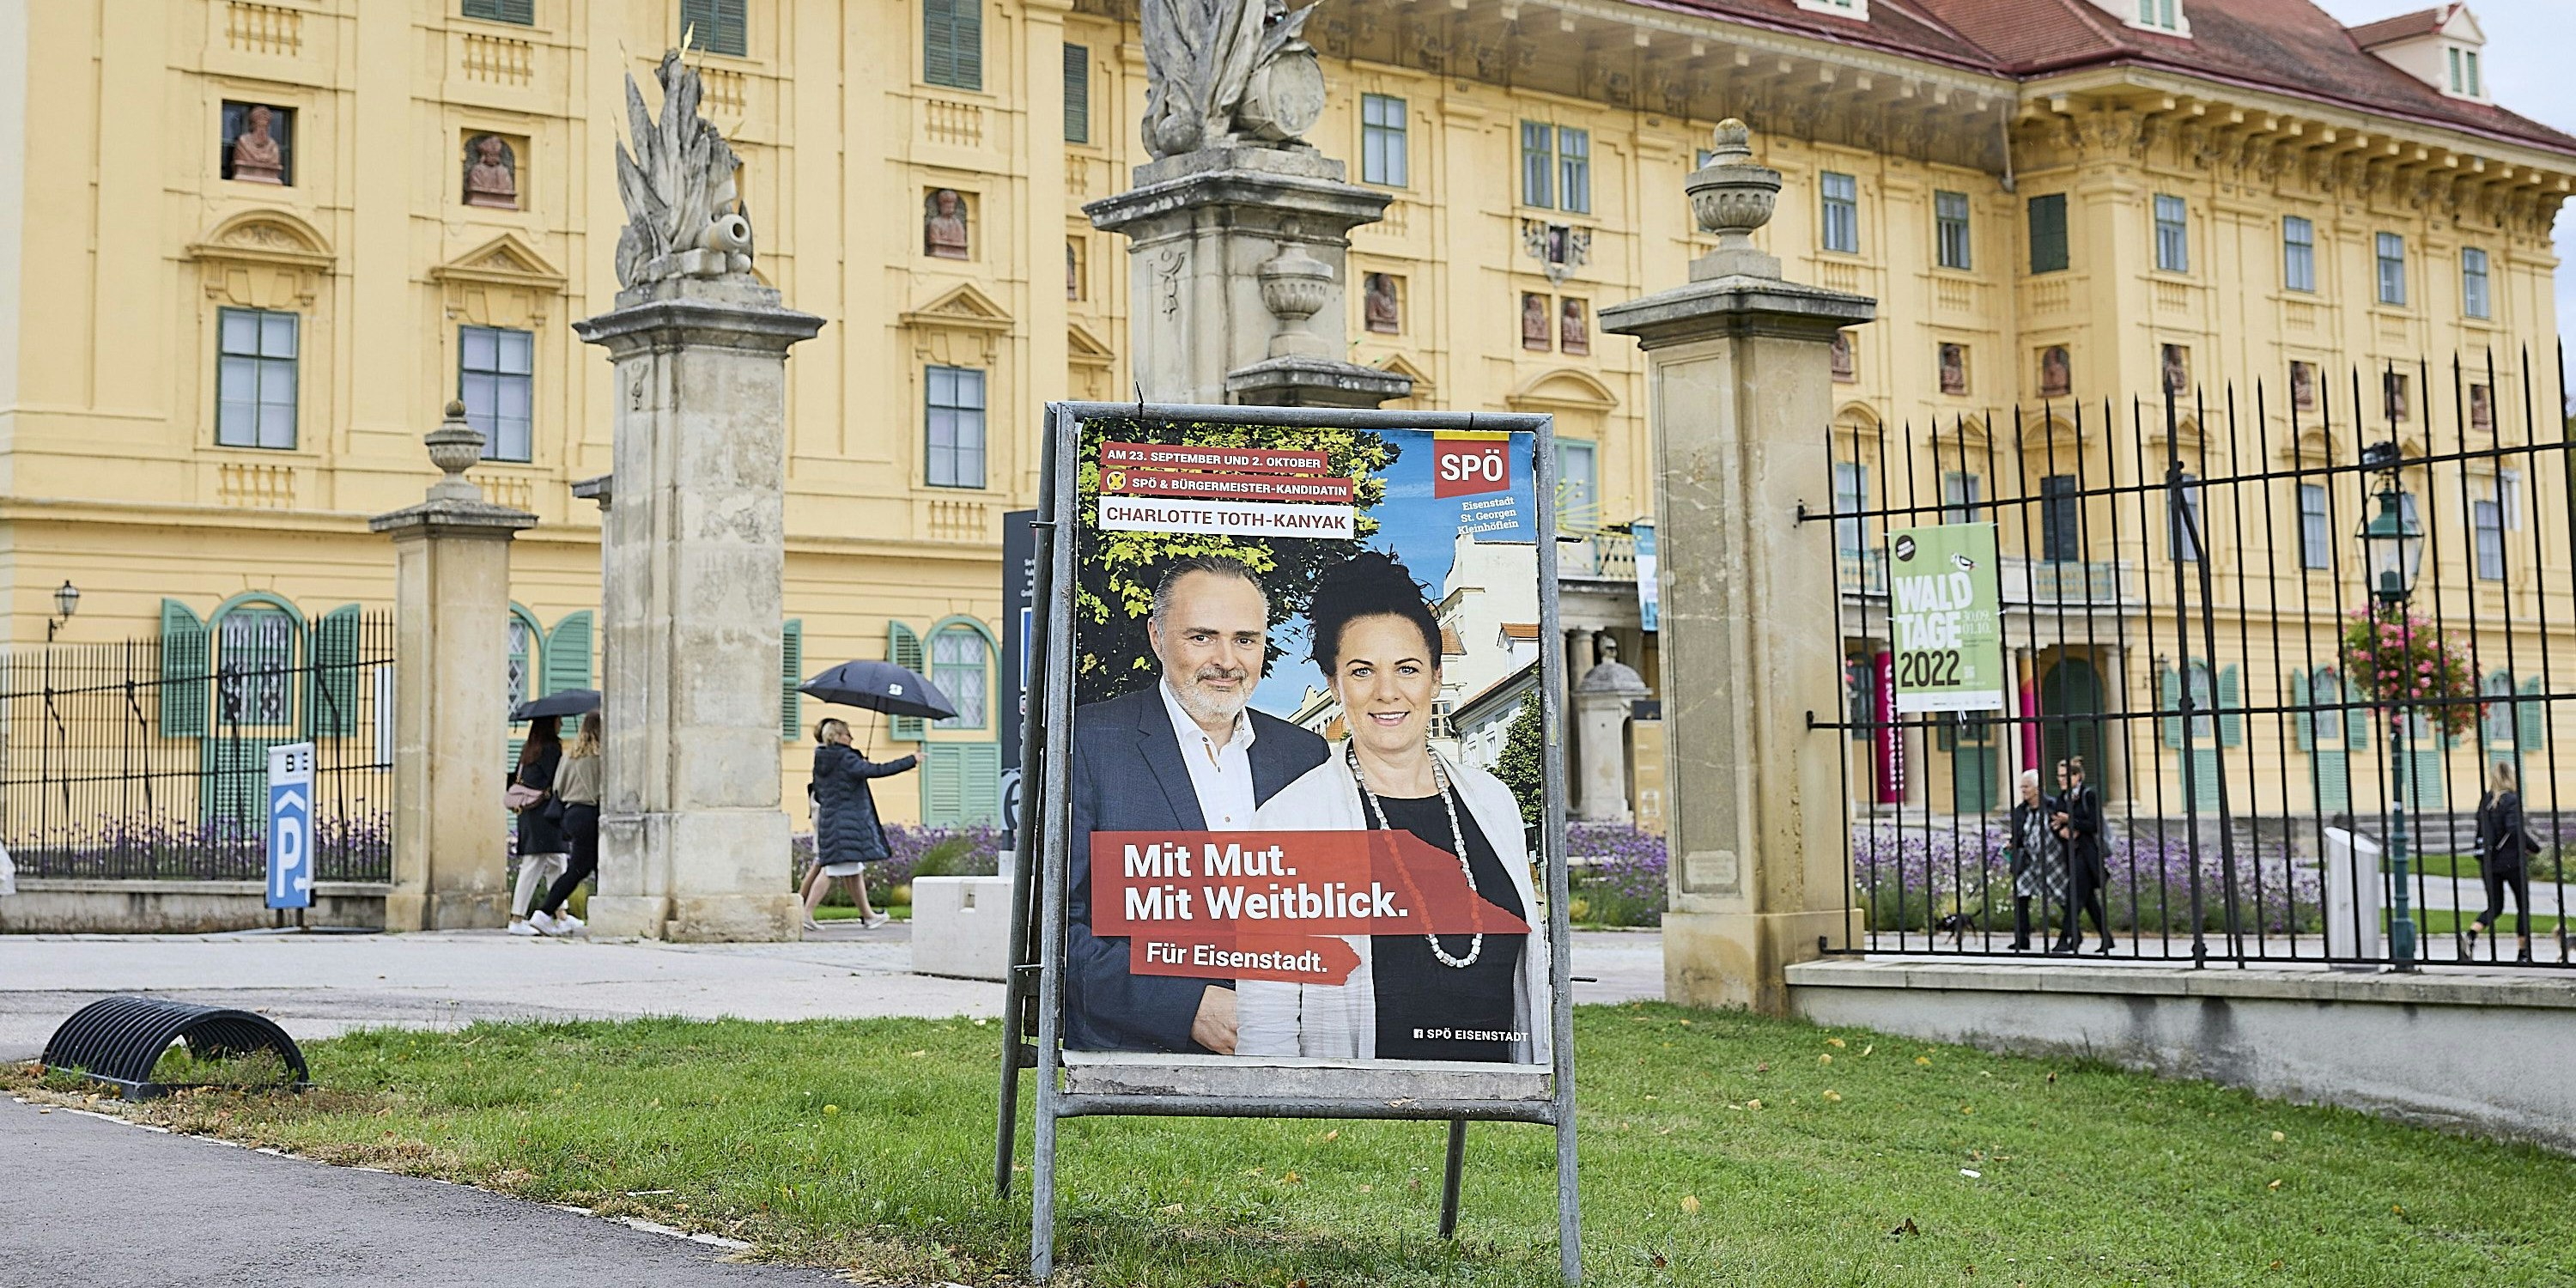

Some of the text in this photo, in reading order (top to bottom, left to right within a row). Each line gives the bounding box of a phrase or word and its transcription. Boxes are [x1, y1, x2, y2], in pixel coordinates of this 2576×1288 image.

[1107, 450, 1321, 469] AM 23. SEPTEMBER UND 2. OKTOBER
[1439, 448, 1504, 482] SPÖ
[1132, 477, 1347, 496] SPÖ & BÜRGERMEISTER-KANDIDATIN
[1107, 507, 1346, 530] CHARLOTTE TOTH-KANYAK
[1461, 496, 1515, 511] Eisenstadt
[1461, 509, 1517, 523] St. Georgen
[1457, 519, 1520, 535] Kleinhöflein
[1894, 571, 1973, 614] WALD
[1897, 611, 1963, 651] TAGE
[1900, 650, 1961, 687] 2022
[276, 816, 302, 898] P
[1124, 841, 1297, 878] Mit Mut.
[1125, 882, 1408, 920] Mit Weitblick.
[1146, 942, 1327, 973] Für Eisenstadt.
[1426, 1027, 1528, 1042] SPÖ EISENSTADT
